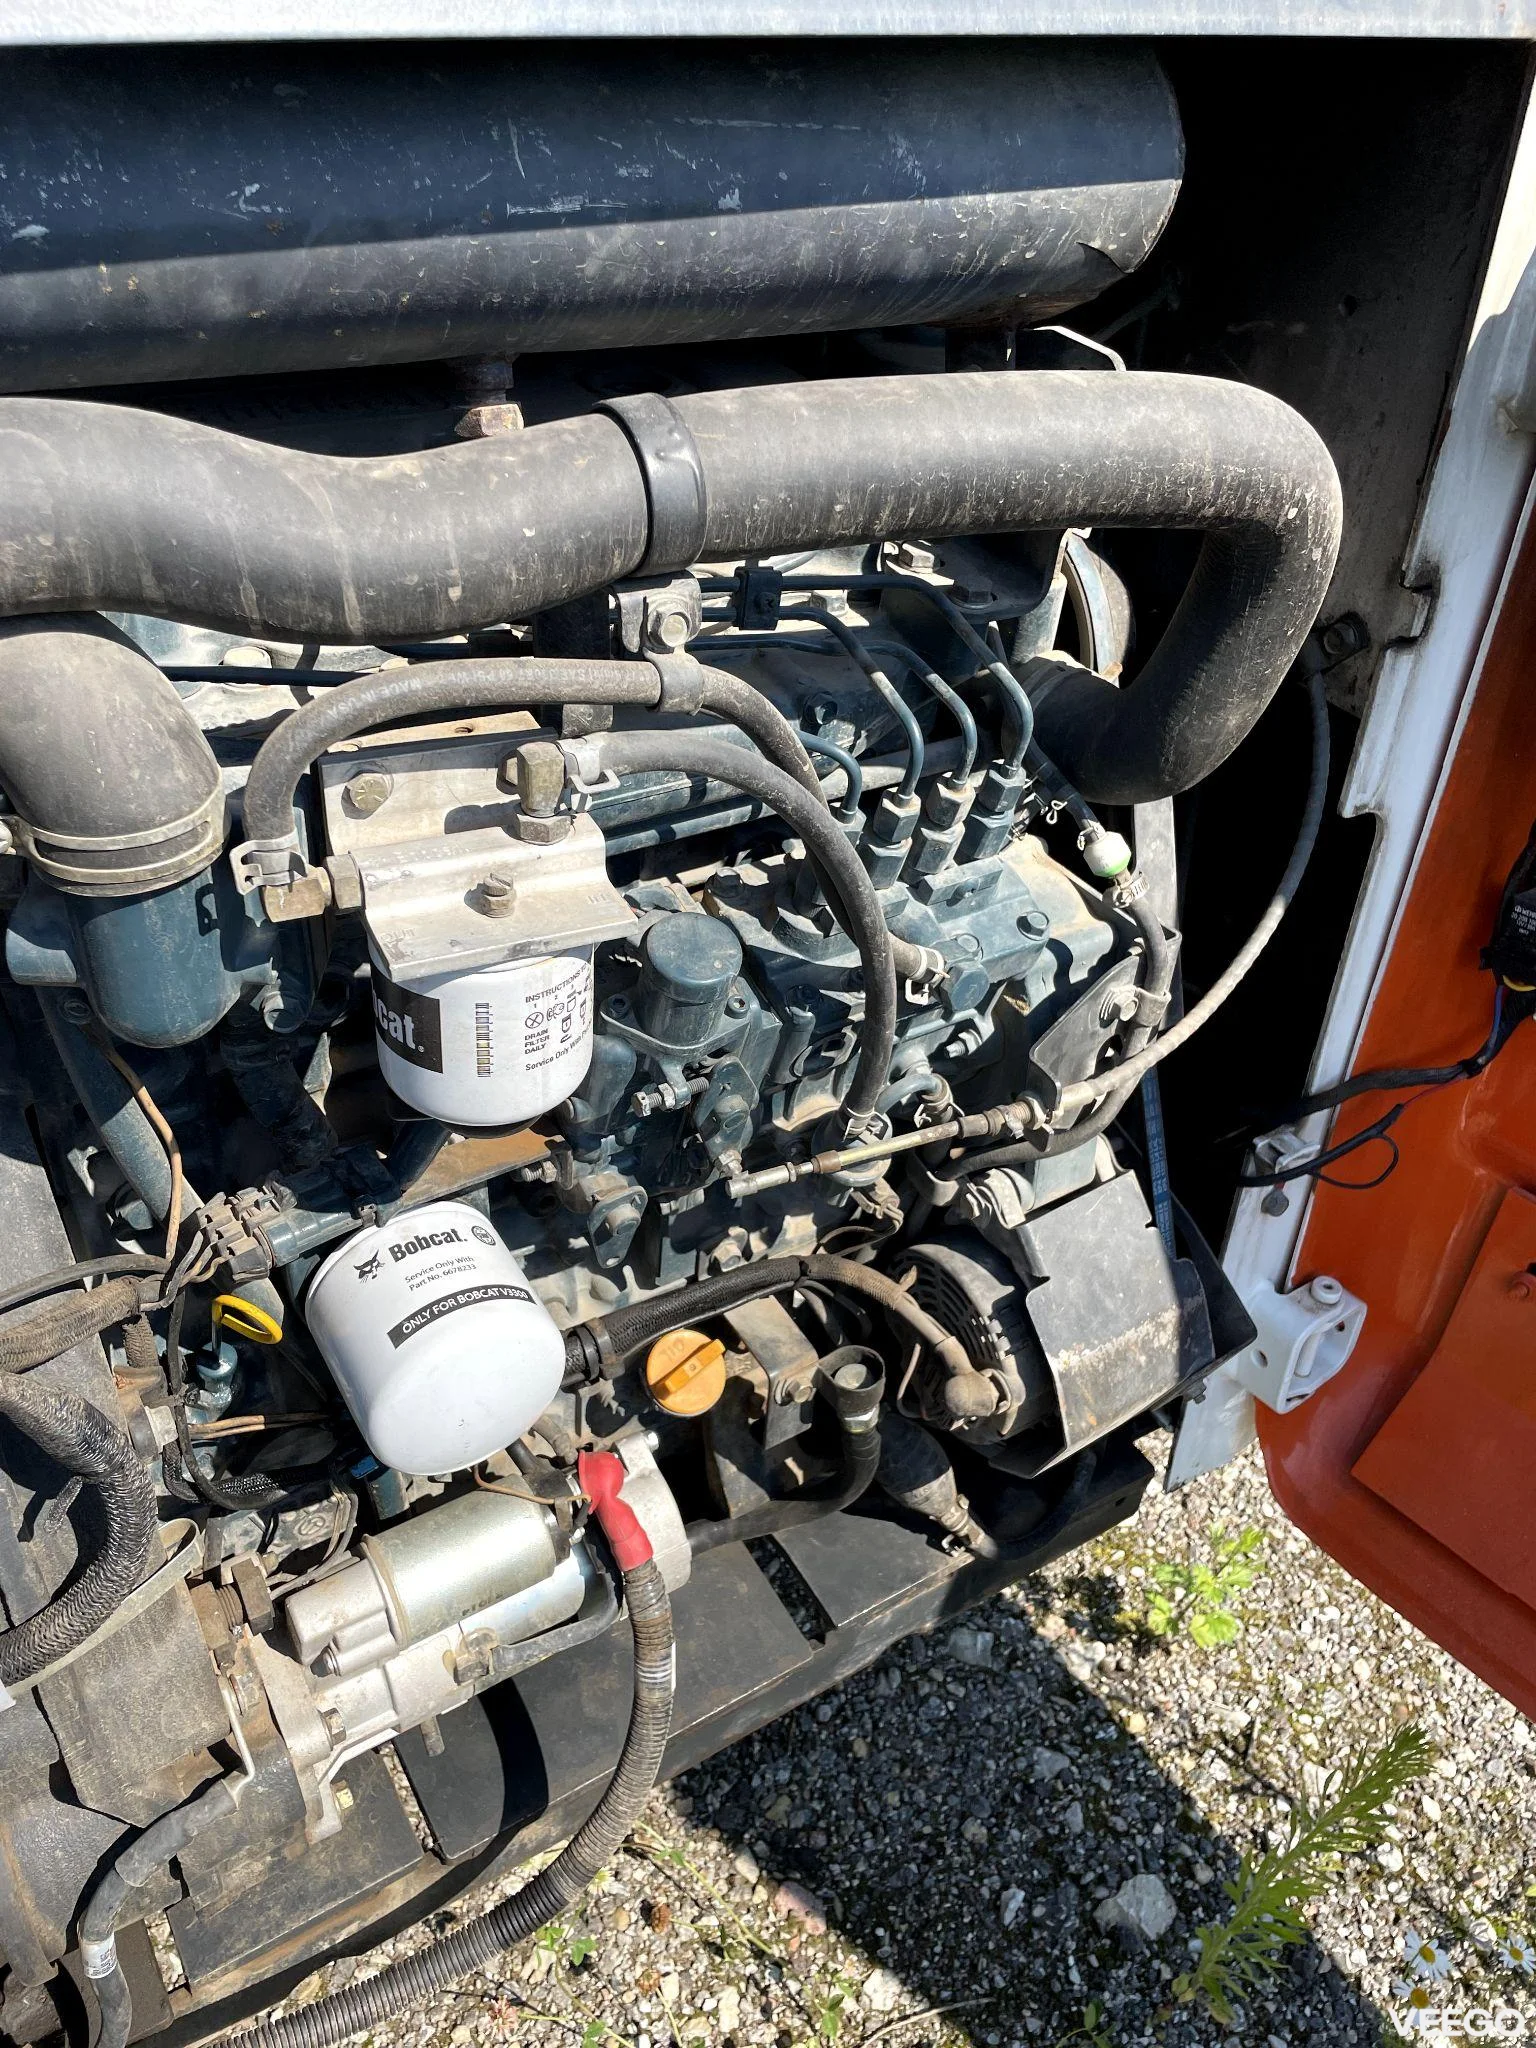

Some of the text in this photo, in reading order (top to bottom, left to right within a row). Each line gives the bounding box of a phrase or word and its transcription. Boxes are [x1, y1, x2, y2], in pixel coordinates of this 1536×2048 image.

[525, 970, 581, 1004] INSTRUCTIONS
[524, 1028, 549, 1041] DRAIN
[524, 1035, 550, 1048] FILTER
[524, 1043, 547, 1055] DAILY
[525, 1055, 554, 1071] Service
[555, 1047, 570, 1059] Only
[404, 1256, 474, 1283] Service Only With
[408, 1263, 477, 1291] Part No. 6678233
[402, 1287, 529, 1334] ONLY FOR BOBCAT V3300
